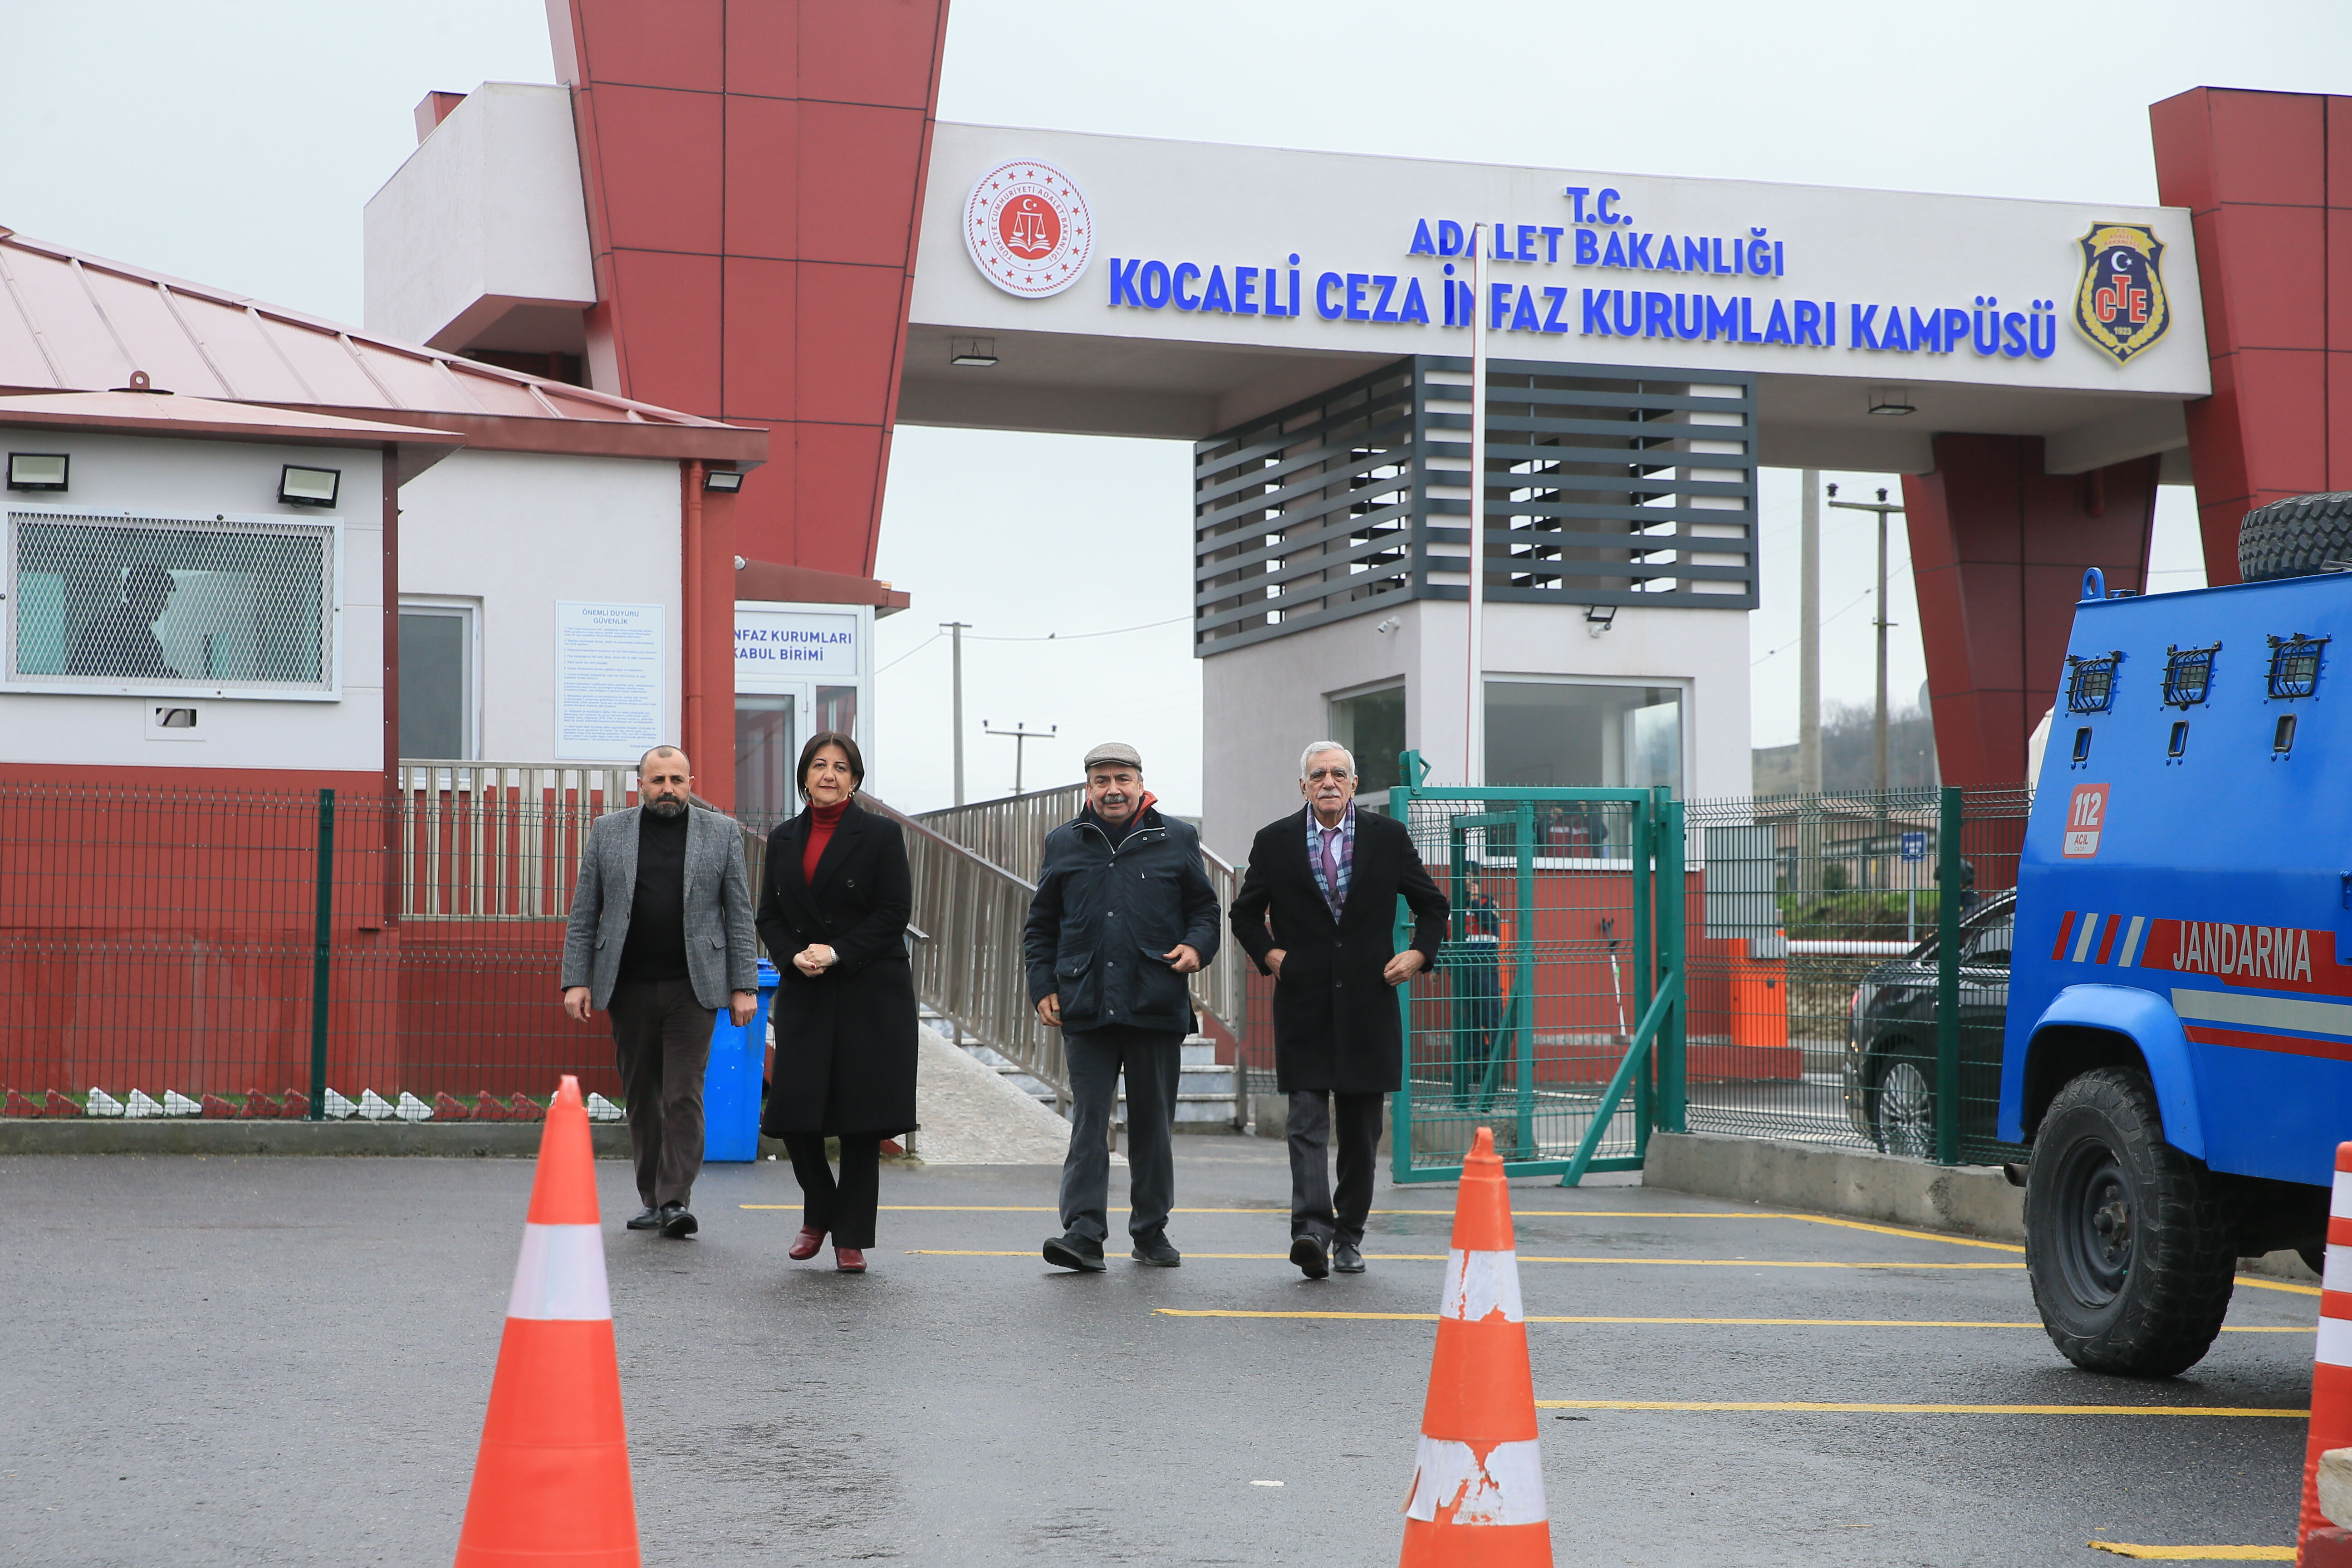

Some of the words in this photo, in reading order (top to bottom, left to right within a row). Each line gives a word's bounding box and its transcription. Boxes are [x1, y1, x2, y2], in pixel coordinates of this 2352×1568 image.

[992, 185, 1035, 222] CUMHURİYETİ
[1037, 189, 1065, 214] ADALET
[1565, 186, 1633, 225] T.C.
[992, 225, 1013, 261] TÜRKİYE
[1049, 216, 1068, 263] BAKANLIĞI
[1575, 227, 1784, 277] BAKANLIĞI
[1109, 253, 1300, 317] KOCAELİ
[1316, 272, 1431, 324] CEZA
[1583, 288, 1836, 347] KURUMLARI
[1851, 295, 2057, 359] KAMPÜSÜ
[2096, 274, 2147, 323] CTE
[2113, 326, 2132, 336] 1923
[582, 608, 608, 616] ÖNEMLİ
[771, 630, 852, 644] KURUMLARI
[780, 646, 823, 661] BİRİMİ
[2073, 792, 2102, 826] 112
[2172, 920, 2313, 983] JANDARMA
